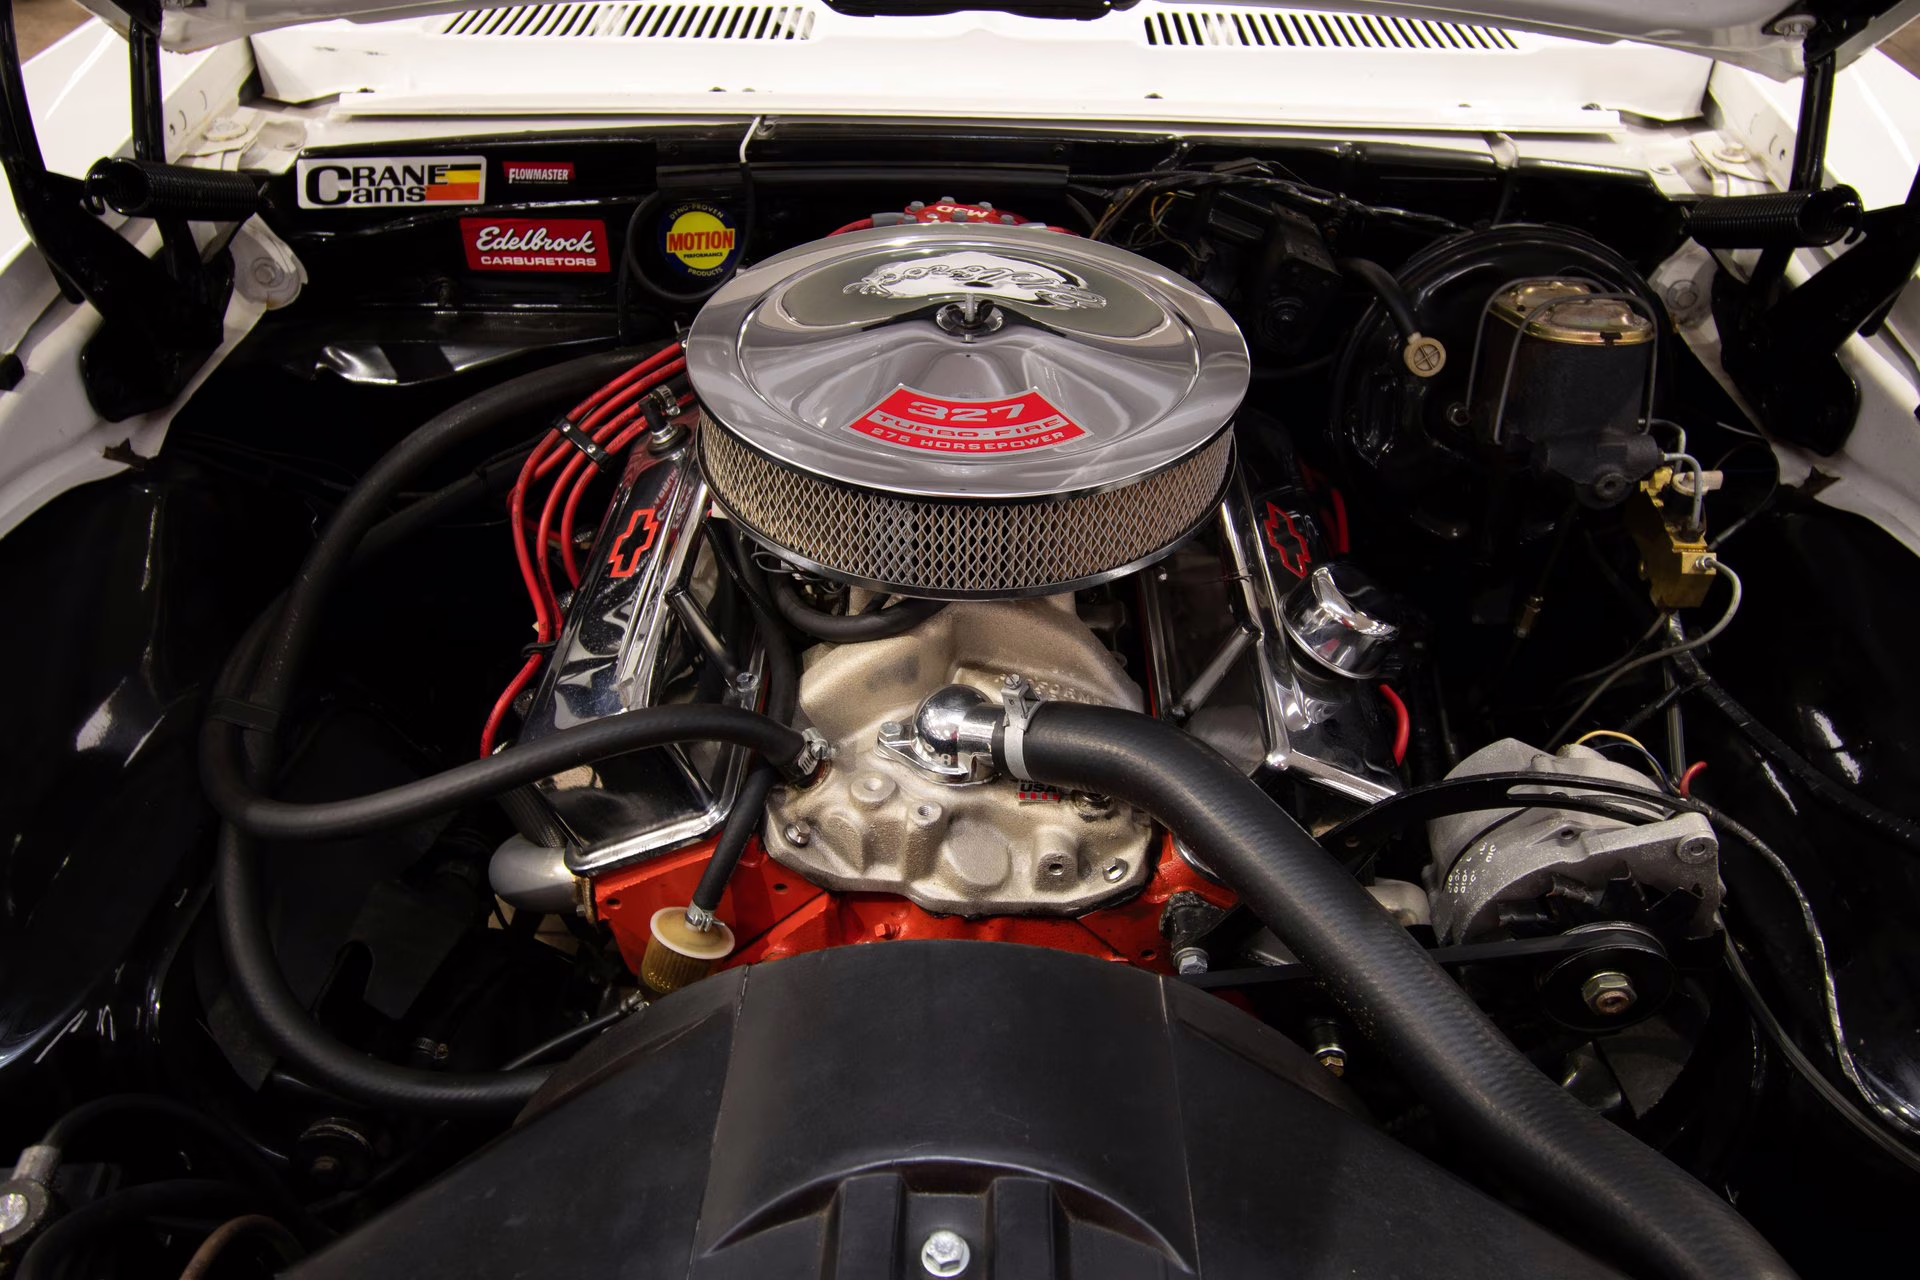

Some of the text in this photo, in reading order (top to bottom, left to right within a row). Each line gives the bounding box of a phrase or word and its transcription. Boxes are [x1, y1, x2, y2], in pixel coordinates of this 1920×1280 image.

[306, 164, 449, 206] CRANE
[508, 167, 569, 184] FLOWMASTER
[476, 226, 596, 254] Edelbrock
[668, 230, 734, 252] MOTION
[480, 255, 597, 267] CARBURETORS
[687, 267, 724, 277] PRODUCTS
[907, 401, 1026, 422] 327
[879, 414, 1063, 439] TURBO-FIRE
[871, 427, 1065, 451] 275 HORSEPOWER
[1020, 783, 1059, 793] USA
